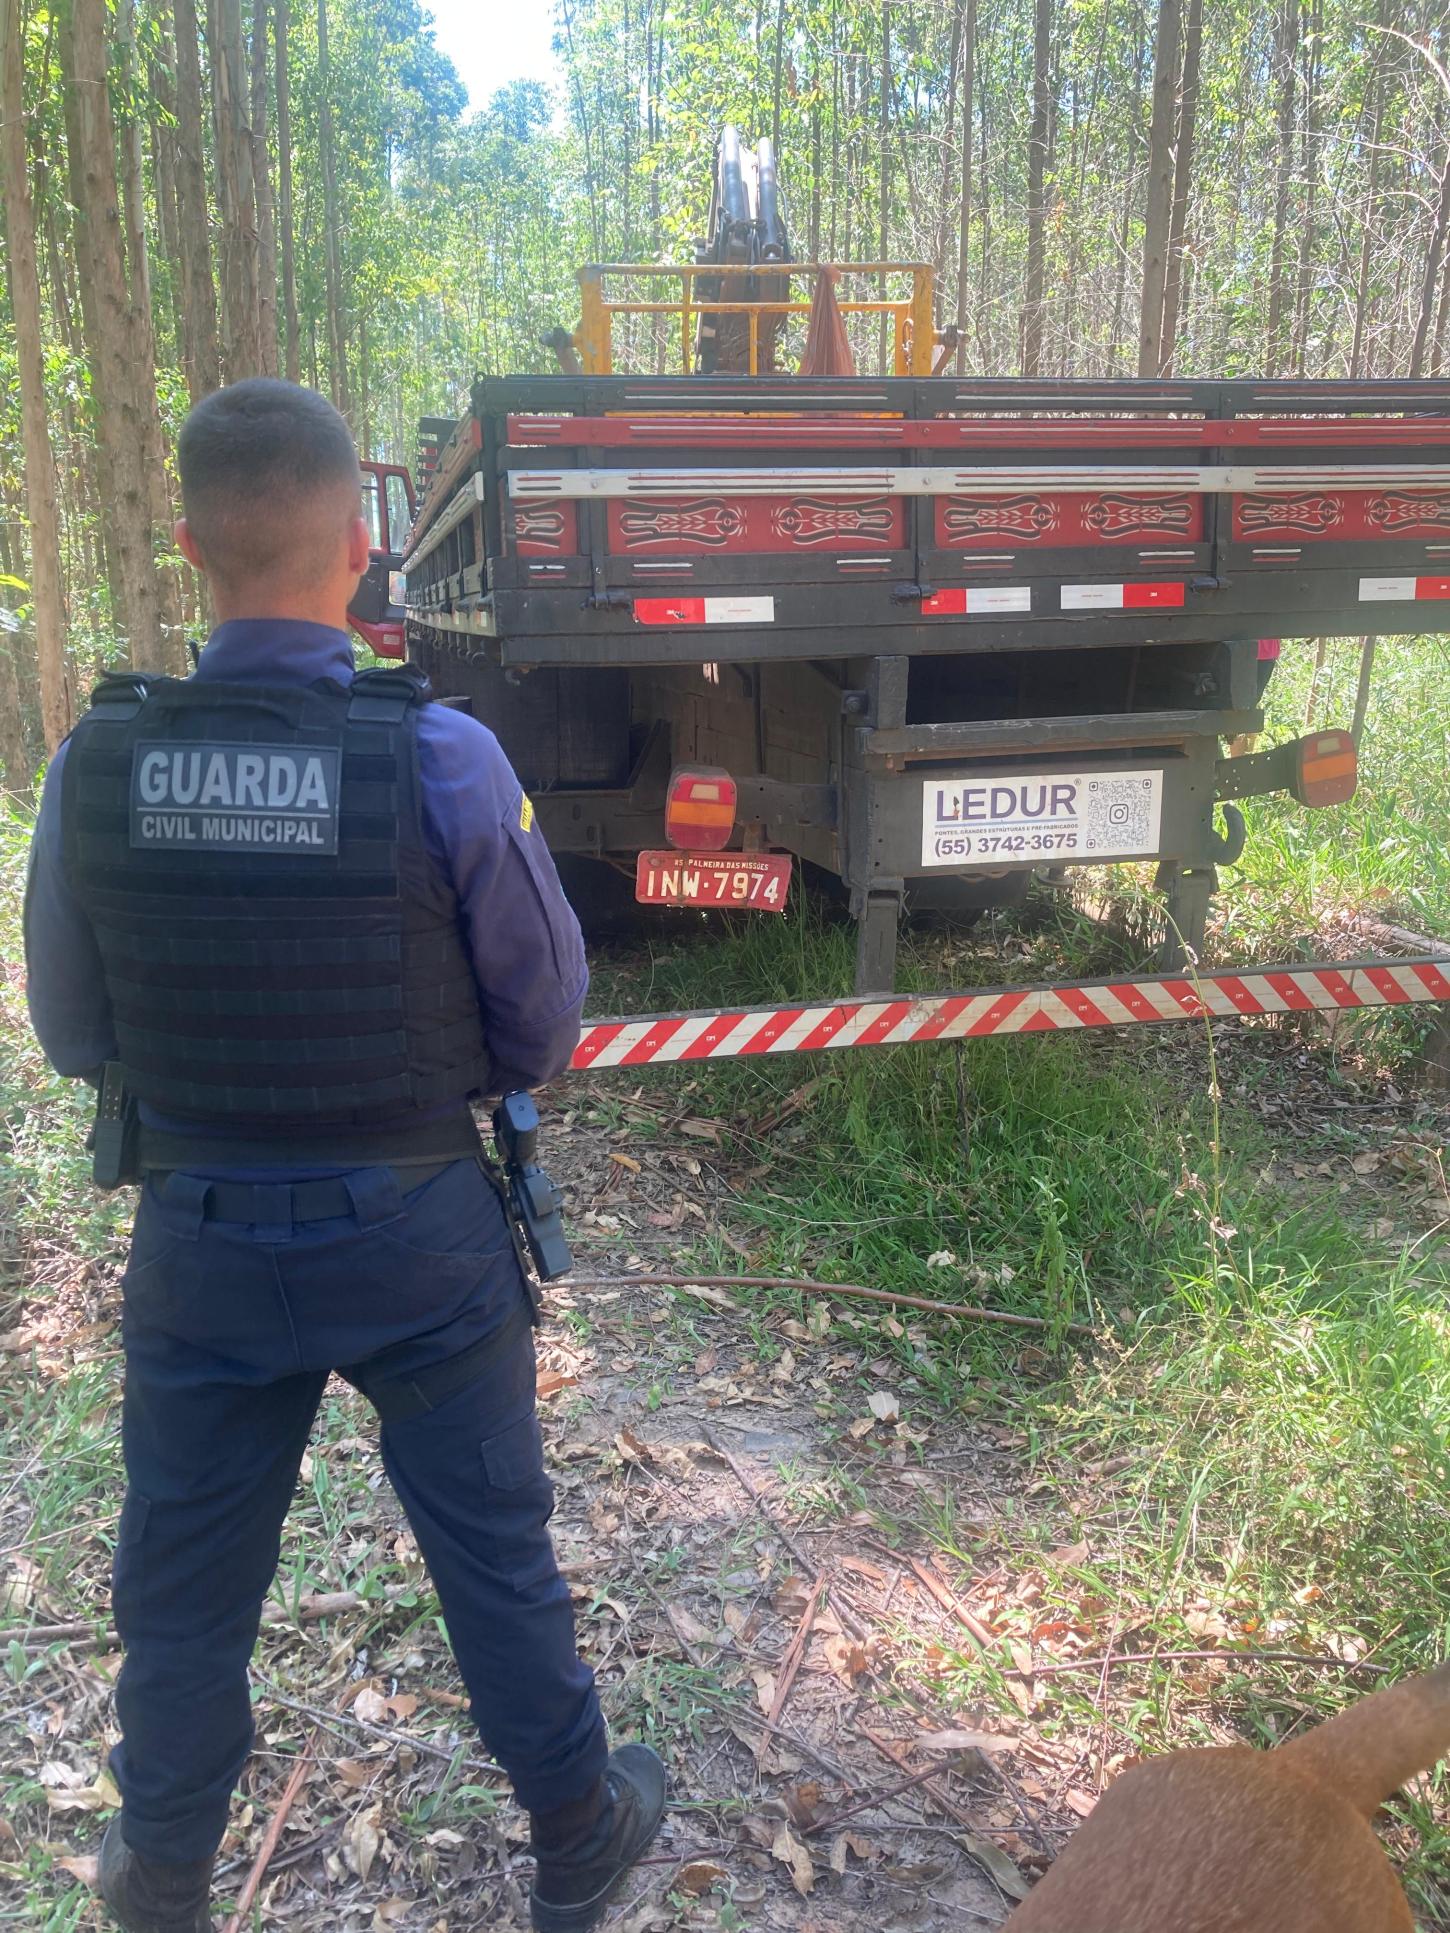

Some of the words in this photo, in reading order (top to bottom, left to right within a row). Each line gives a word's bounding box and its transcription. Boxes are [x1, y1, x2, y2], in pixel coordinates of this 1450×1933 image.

[139, 751, 329, 809] GUARDA
[142, 816, 196, 840] CIVIL
[202, 817, 324, 844] MUNICIPAL
[935, 837, 971, 857] (55)
[978, 833, 1077, 853] 3742-3675
[688, 859, 724, 869] PALMEIRA
[726, 861, 740, 869] DAS
